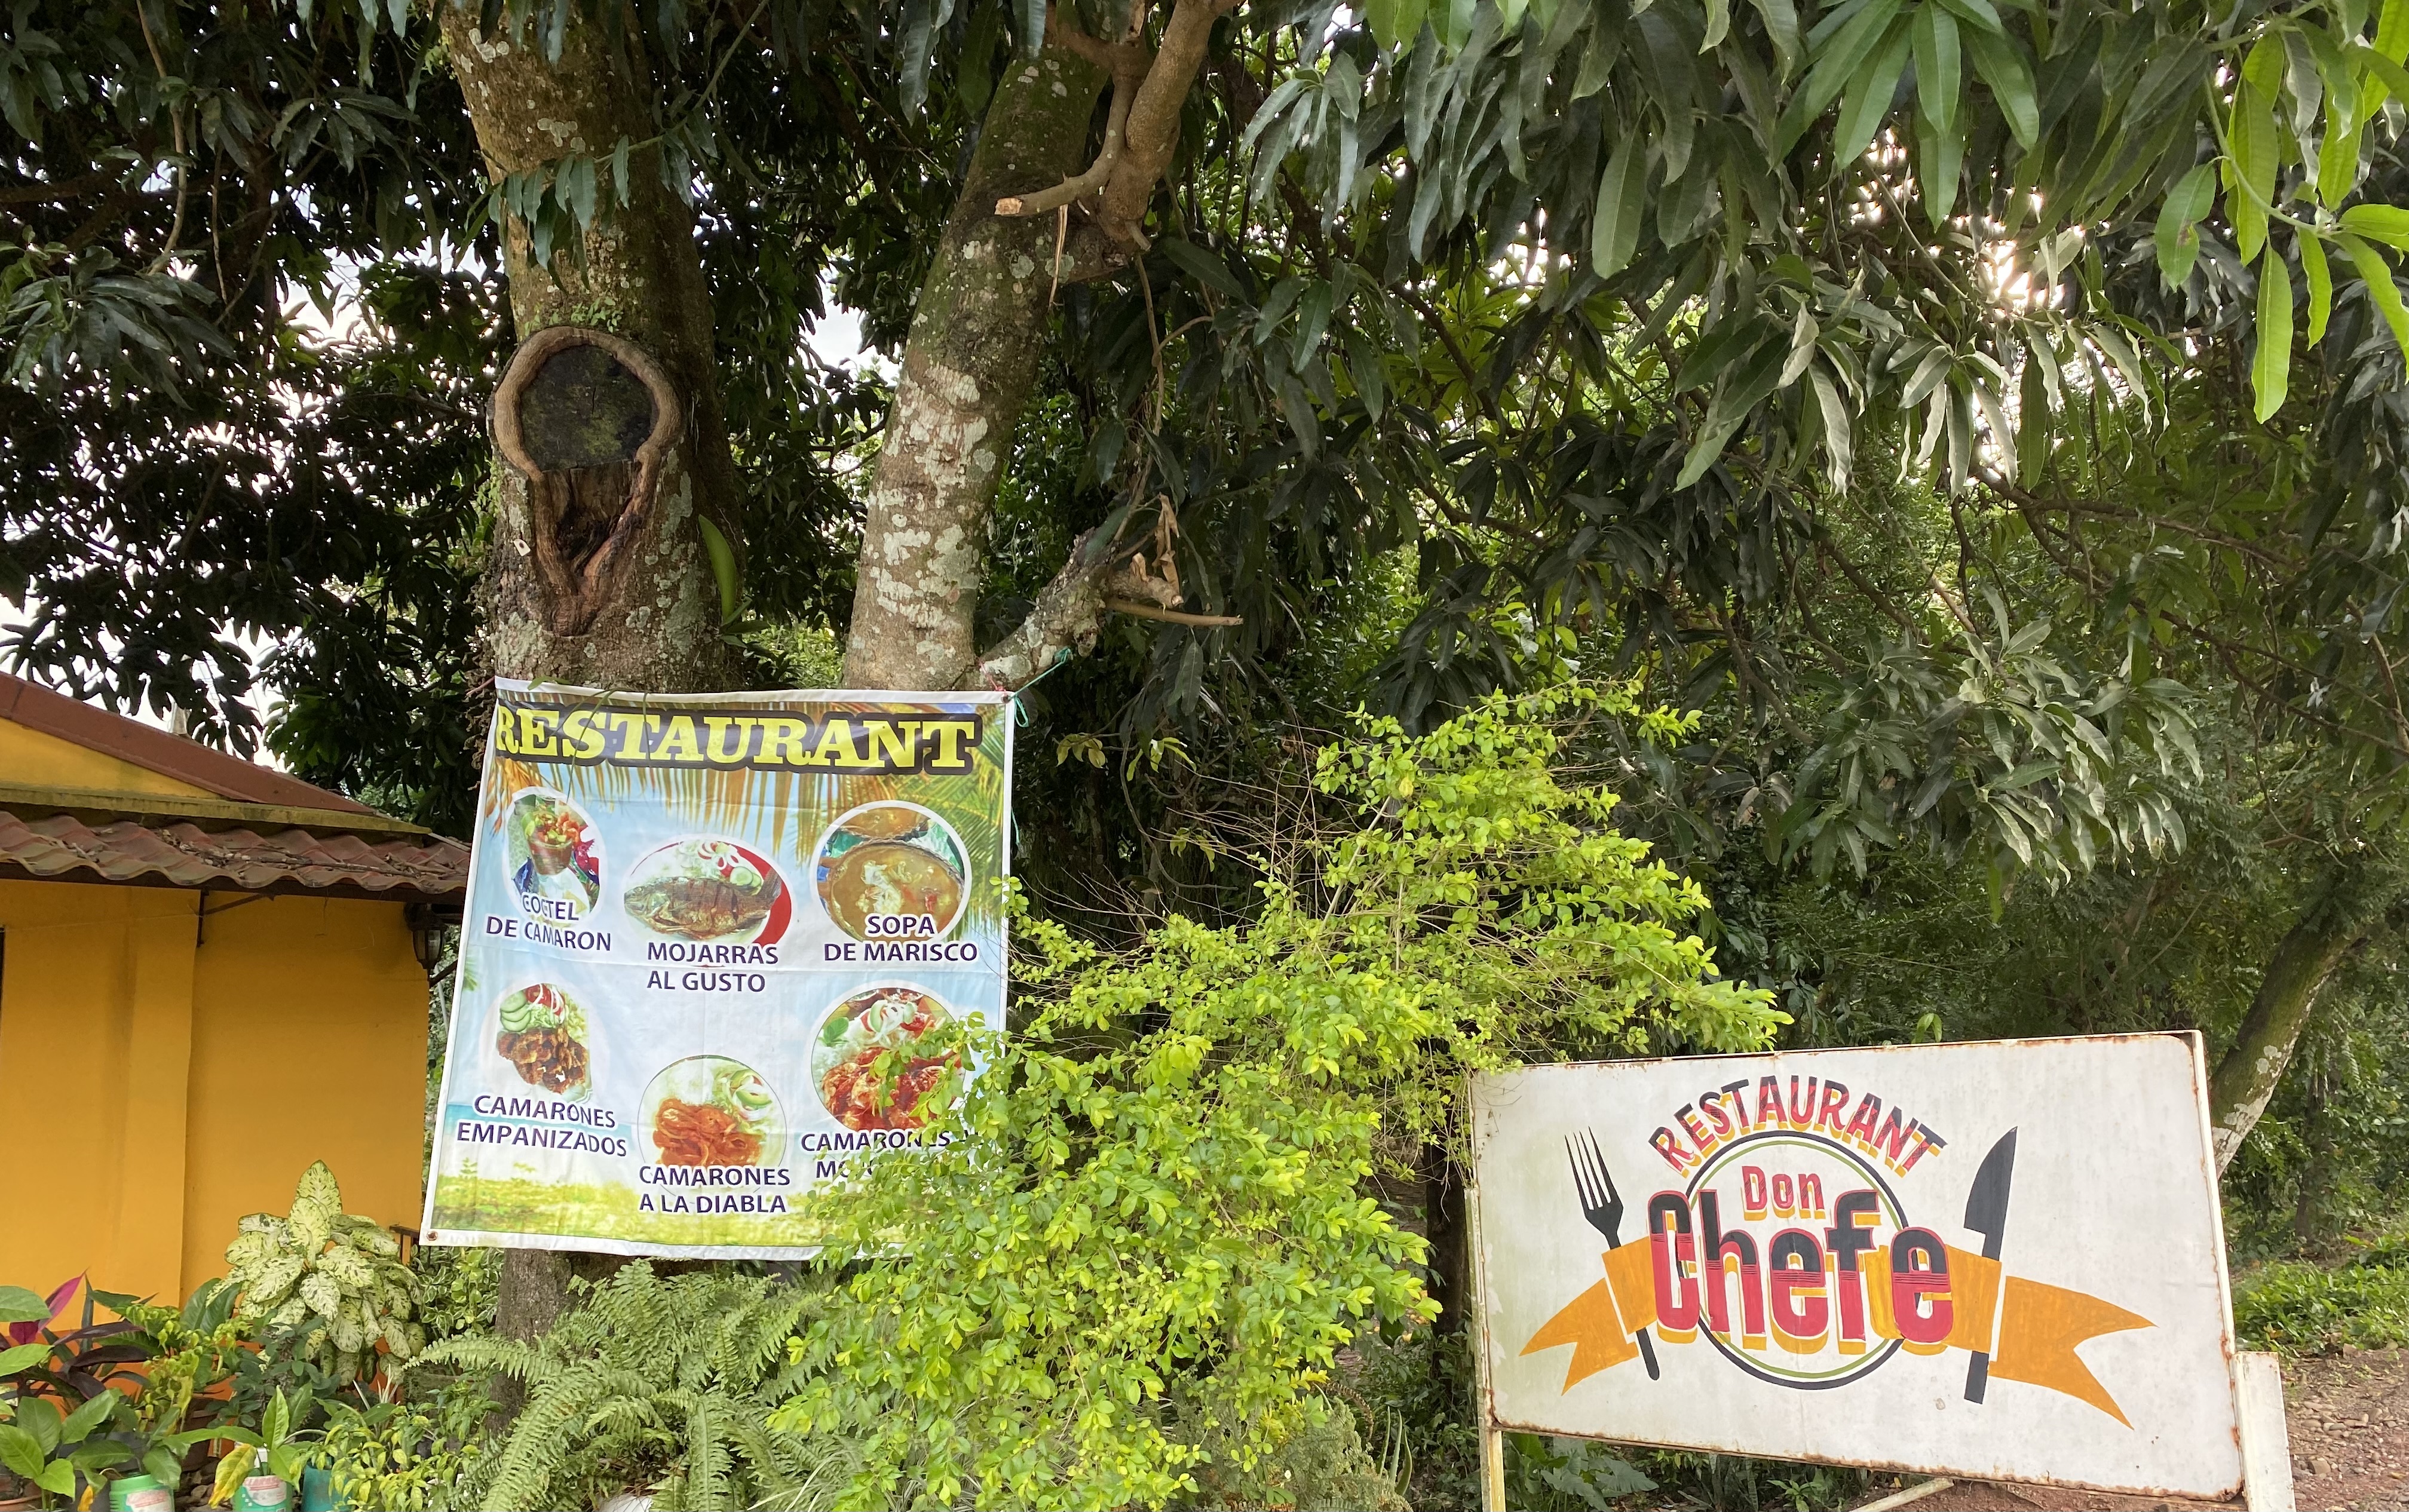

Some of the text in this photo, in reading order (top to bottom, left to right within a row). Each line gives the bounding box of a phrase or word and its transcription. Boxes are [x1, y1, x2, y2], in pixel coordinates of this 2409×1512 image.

[496, 706, 976, 768] RESTAURANT
[522, 895, 579, 921] COCTEL
[486, 916, 611, 951] DE CAMARON
[868, 916, 934, 934] SOPA
[648, 942, 779, 964] MOJARRAS
[824, 943, 977, 961] DE MARISCO
[646, 970, 765, 992] AL GUSTO
[474, 1095, 615, 1128] CAMARONES
[1648, 1075, 1948, 1175] RESTAURANT
[457, 1122, 627, 1157] EMPANIZADOS
[801, 1131, 950, 1151] CAMARONS
[639, 1166, 790, 1186] CAMARONES
[1742, 1166, 1825, 1214] Don
[639, 1194, 786, 1213] A LA DIABLA
[1648, 1189, 1953, 1347] Chefe
